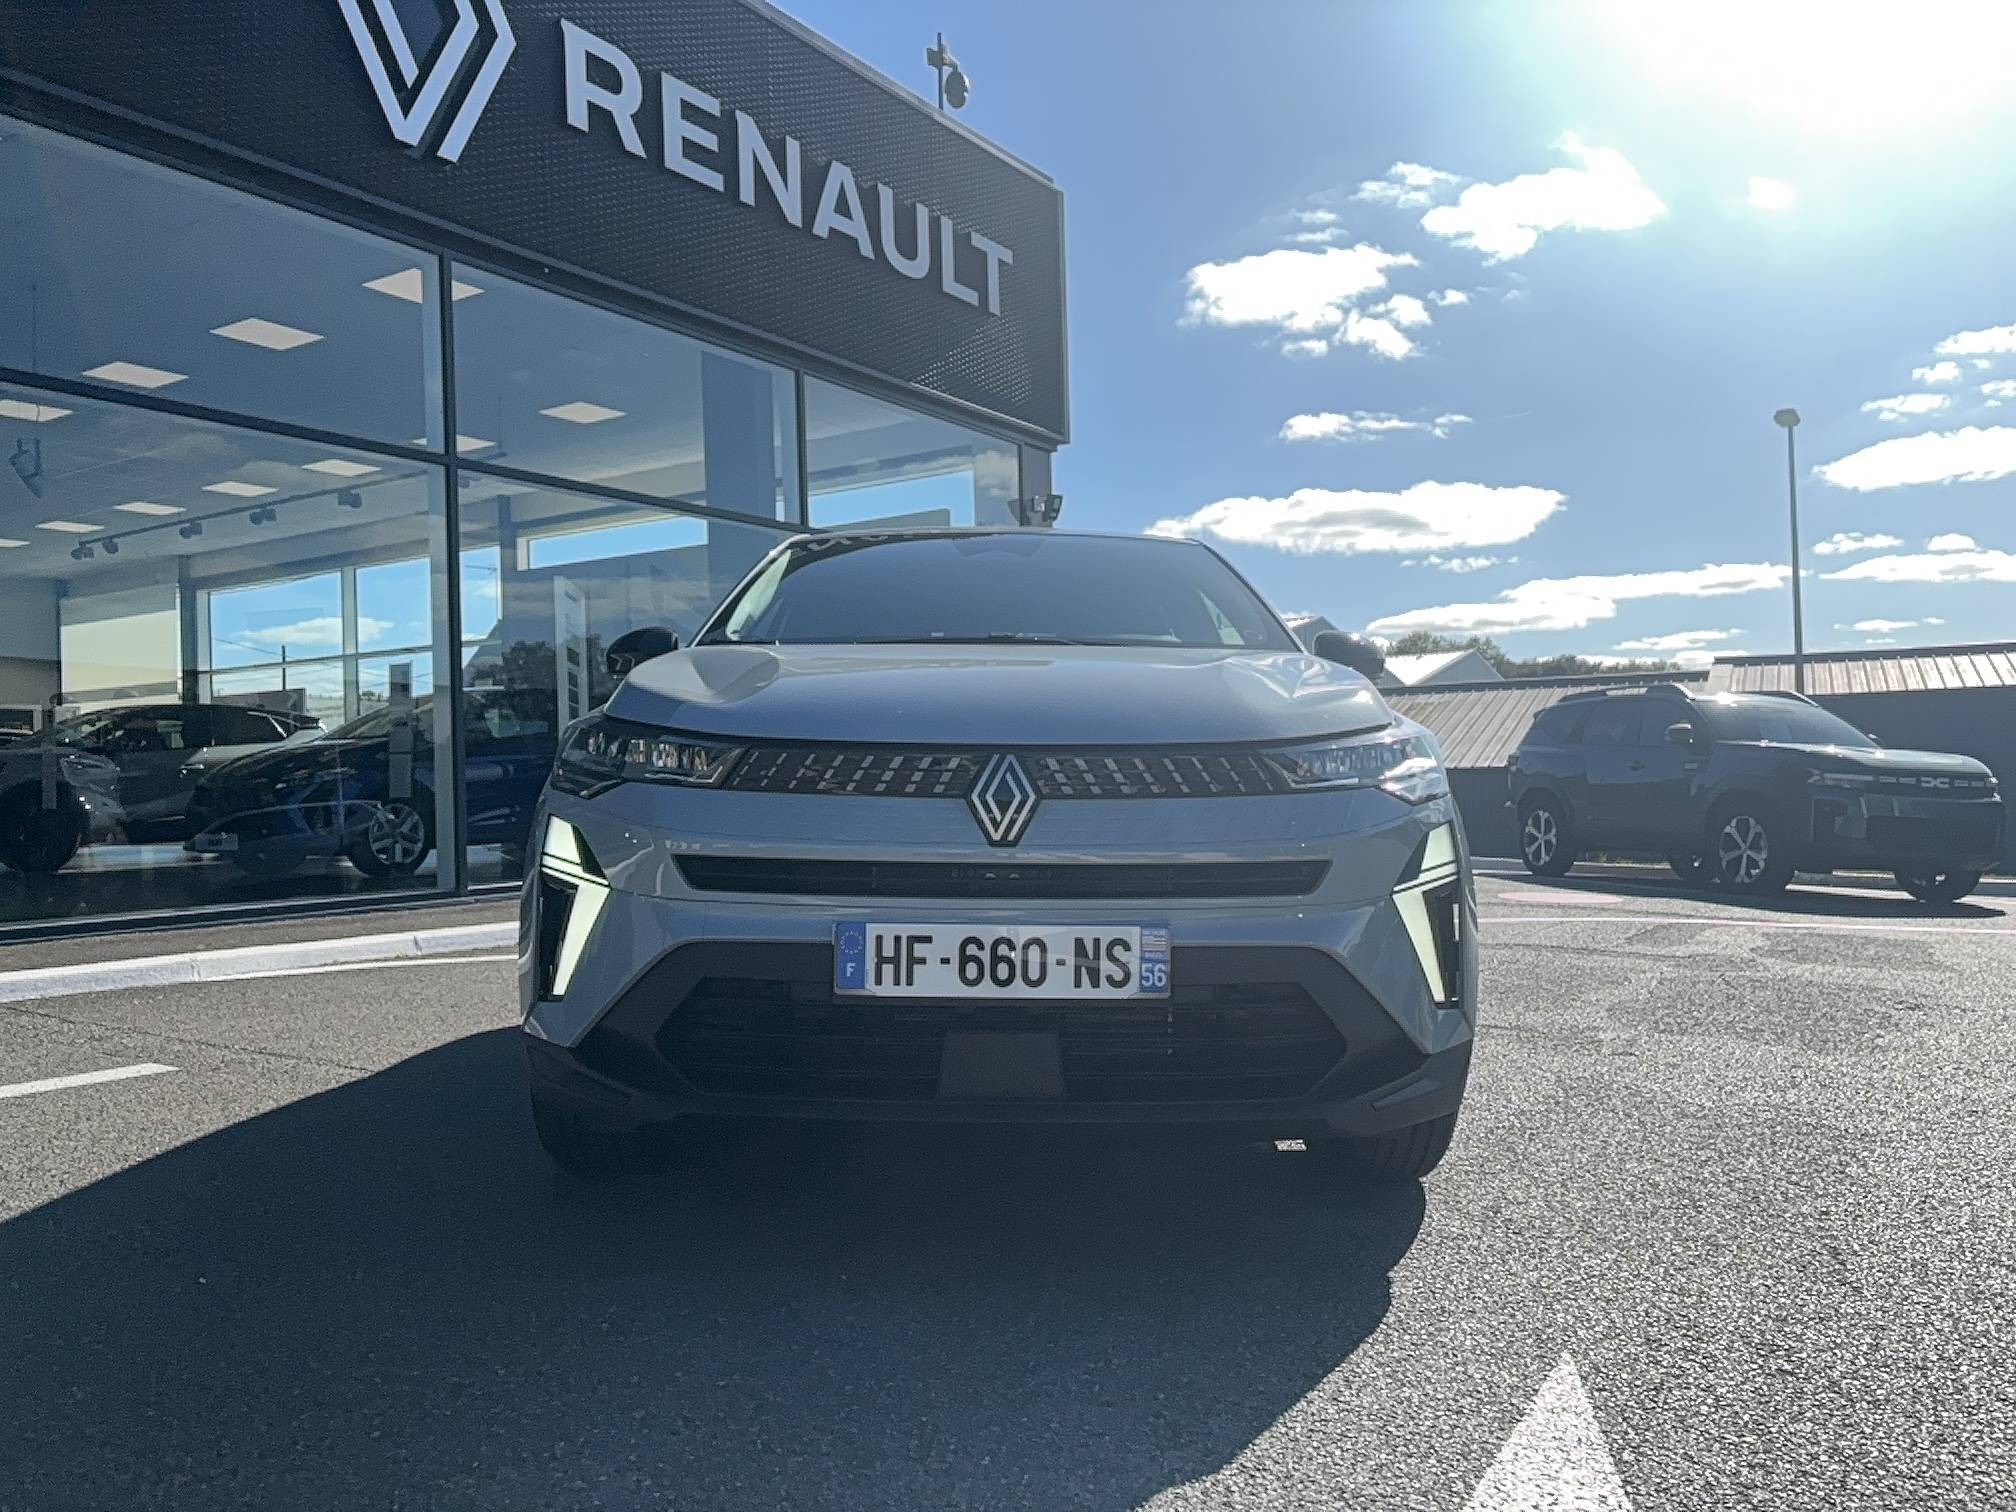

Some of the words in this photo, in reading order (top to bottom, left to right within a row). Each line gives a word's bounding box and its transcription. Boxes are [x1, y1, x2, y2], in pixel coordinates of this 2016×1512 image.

[561, 17, 1014, 316] RENAULT
[846, 962, 857, 977] F
[874, 934, 1132, 989] HF-660-NS
[1141, 962, 1167, 987] 56
